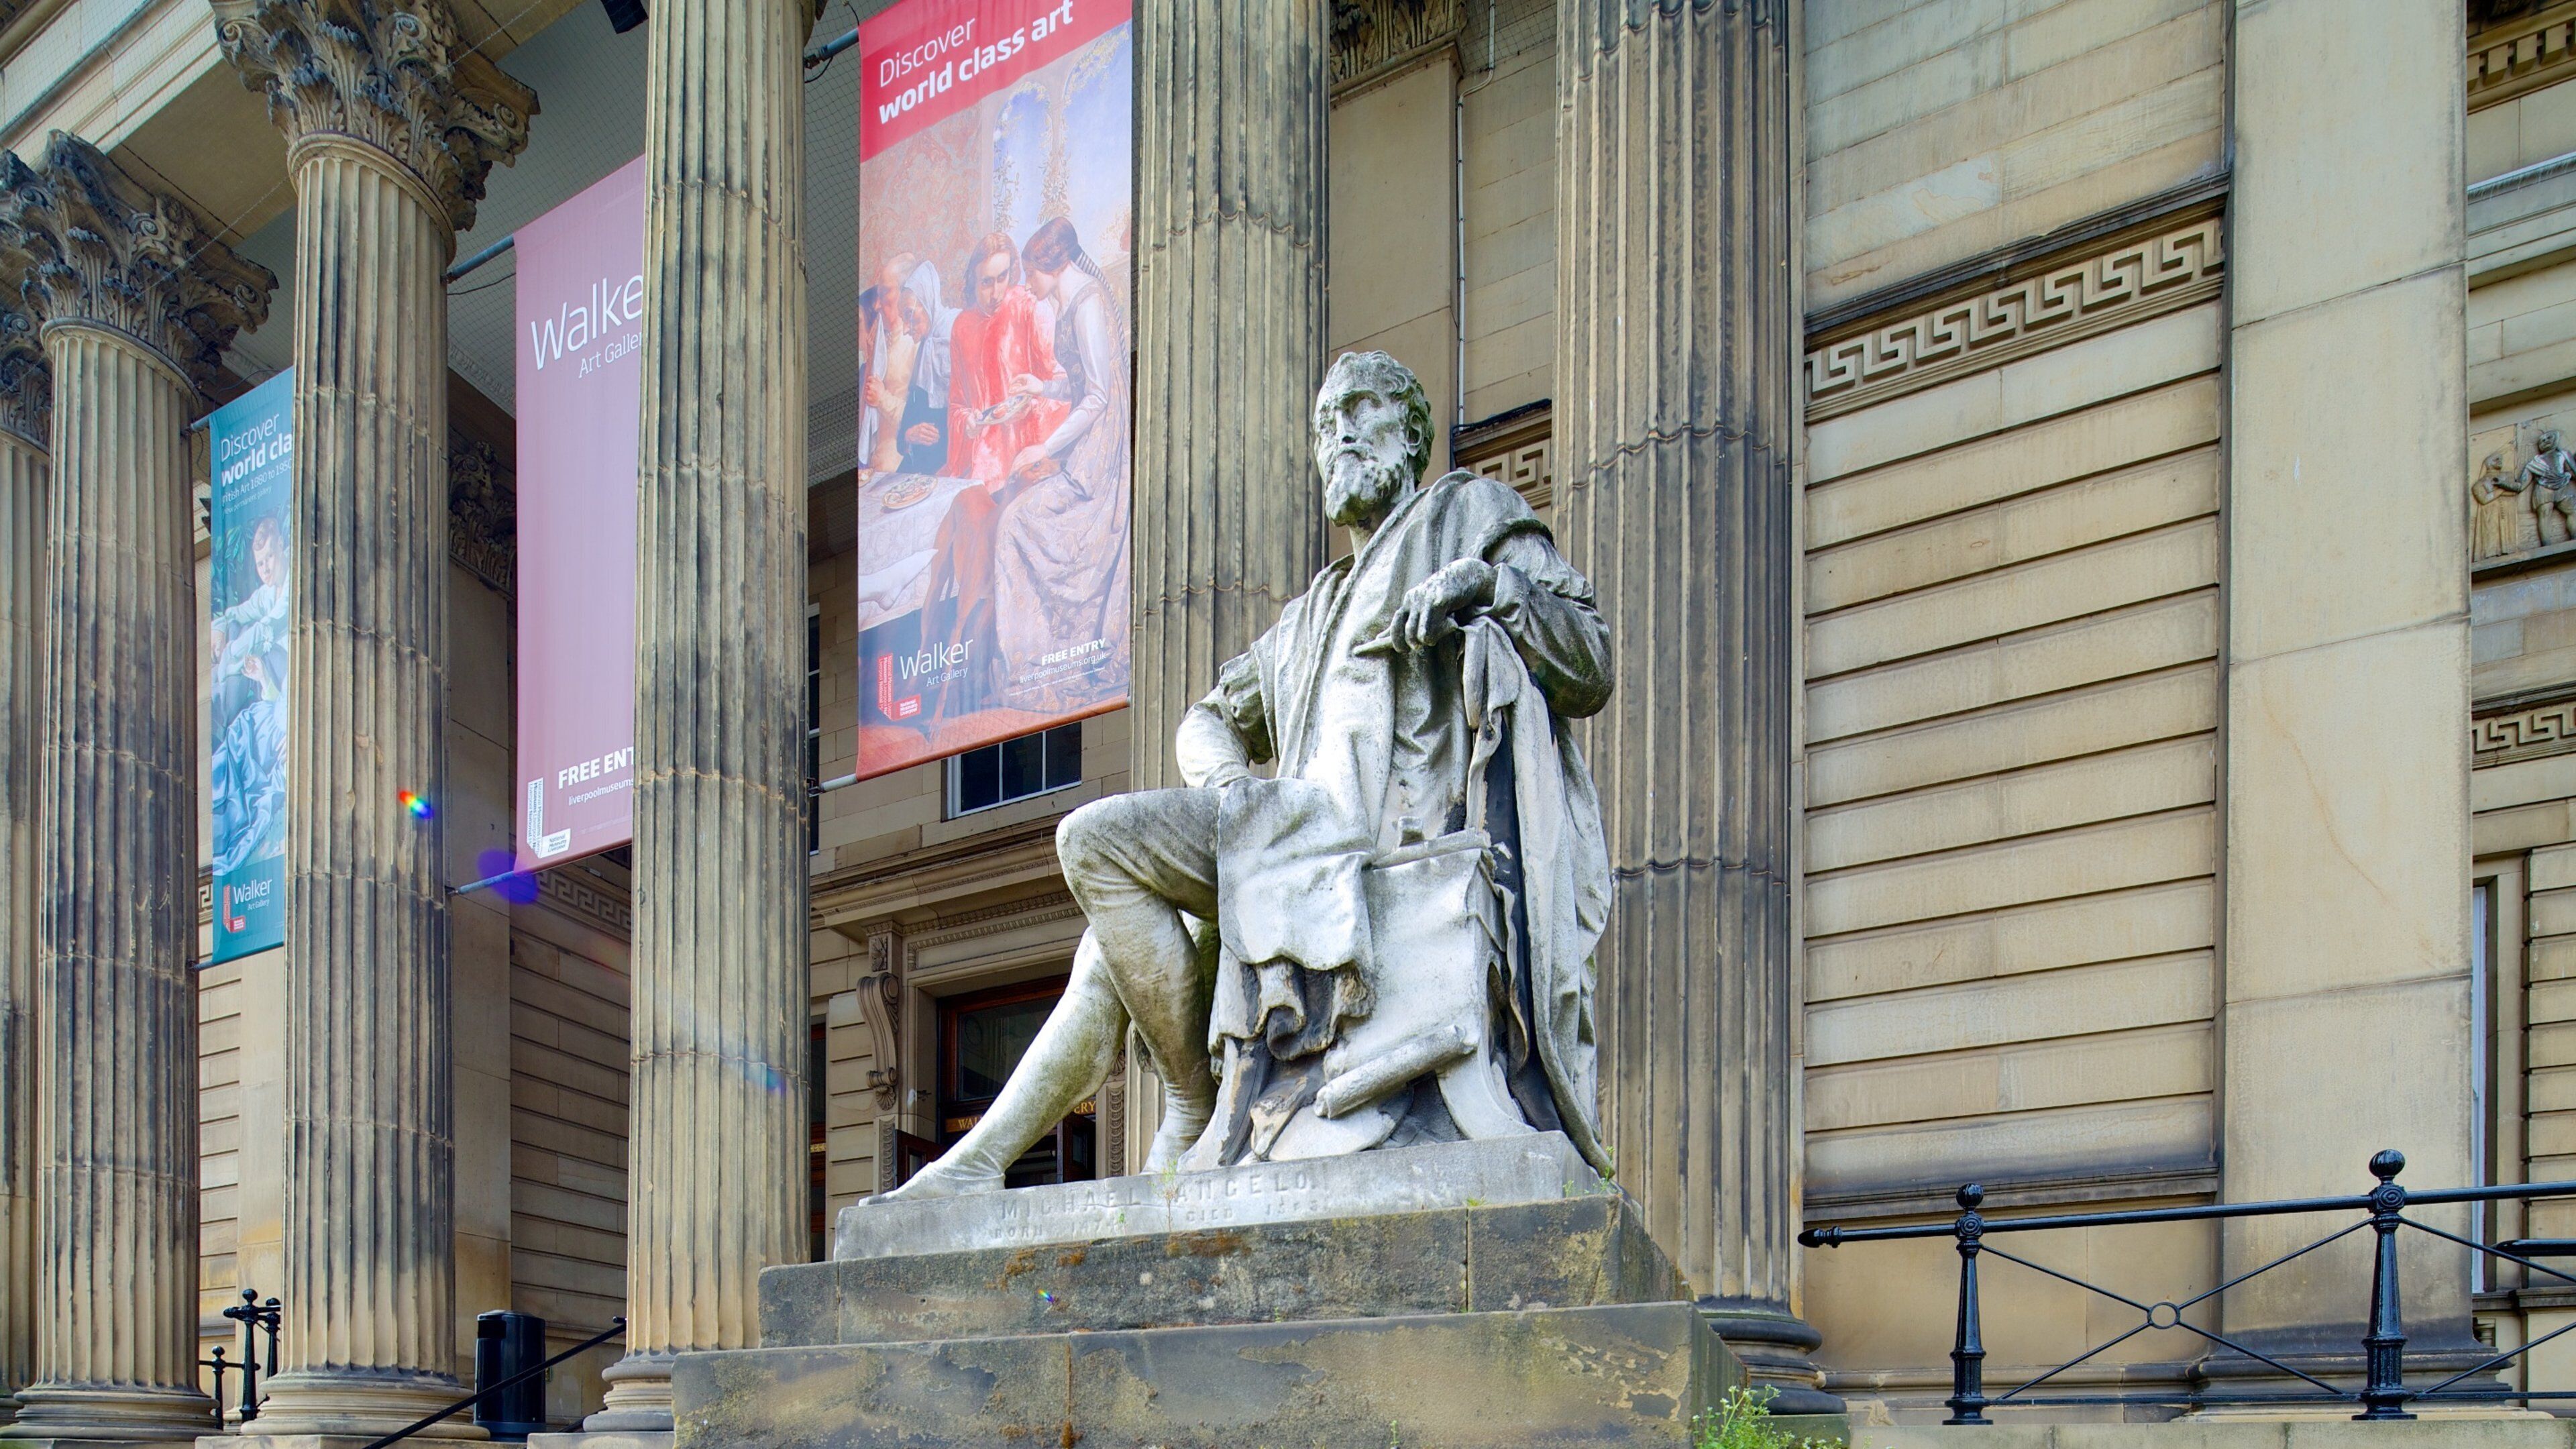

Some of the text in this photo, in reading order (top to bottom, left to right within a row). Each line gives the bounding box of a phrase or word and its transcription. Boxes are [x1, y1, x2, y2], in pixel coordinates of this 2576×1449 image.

[879, 0, 1073, 124] world class art
[880, 17, 975, 87] Discover
[578, 352, 601, 378] Art
[221, 413, 280, 462] Discover
[221, 443, 266, 487] world
[900, 638, 974, 680] Walker
[1019, 651, 1107, 684] liverpoolmuseums.org.uk
[1041, 637, 1106, 666] FREE ENTRY
[926, 667, 968, 687] Art Gallery
[558, 757, 600, 789] FREE
[233, 879, 272, 904] Walker
[256, 899, 270, 909] Gallery
[1001, 1187, 1141, 1220] MICHAEL
